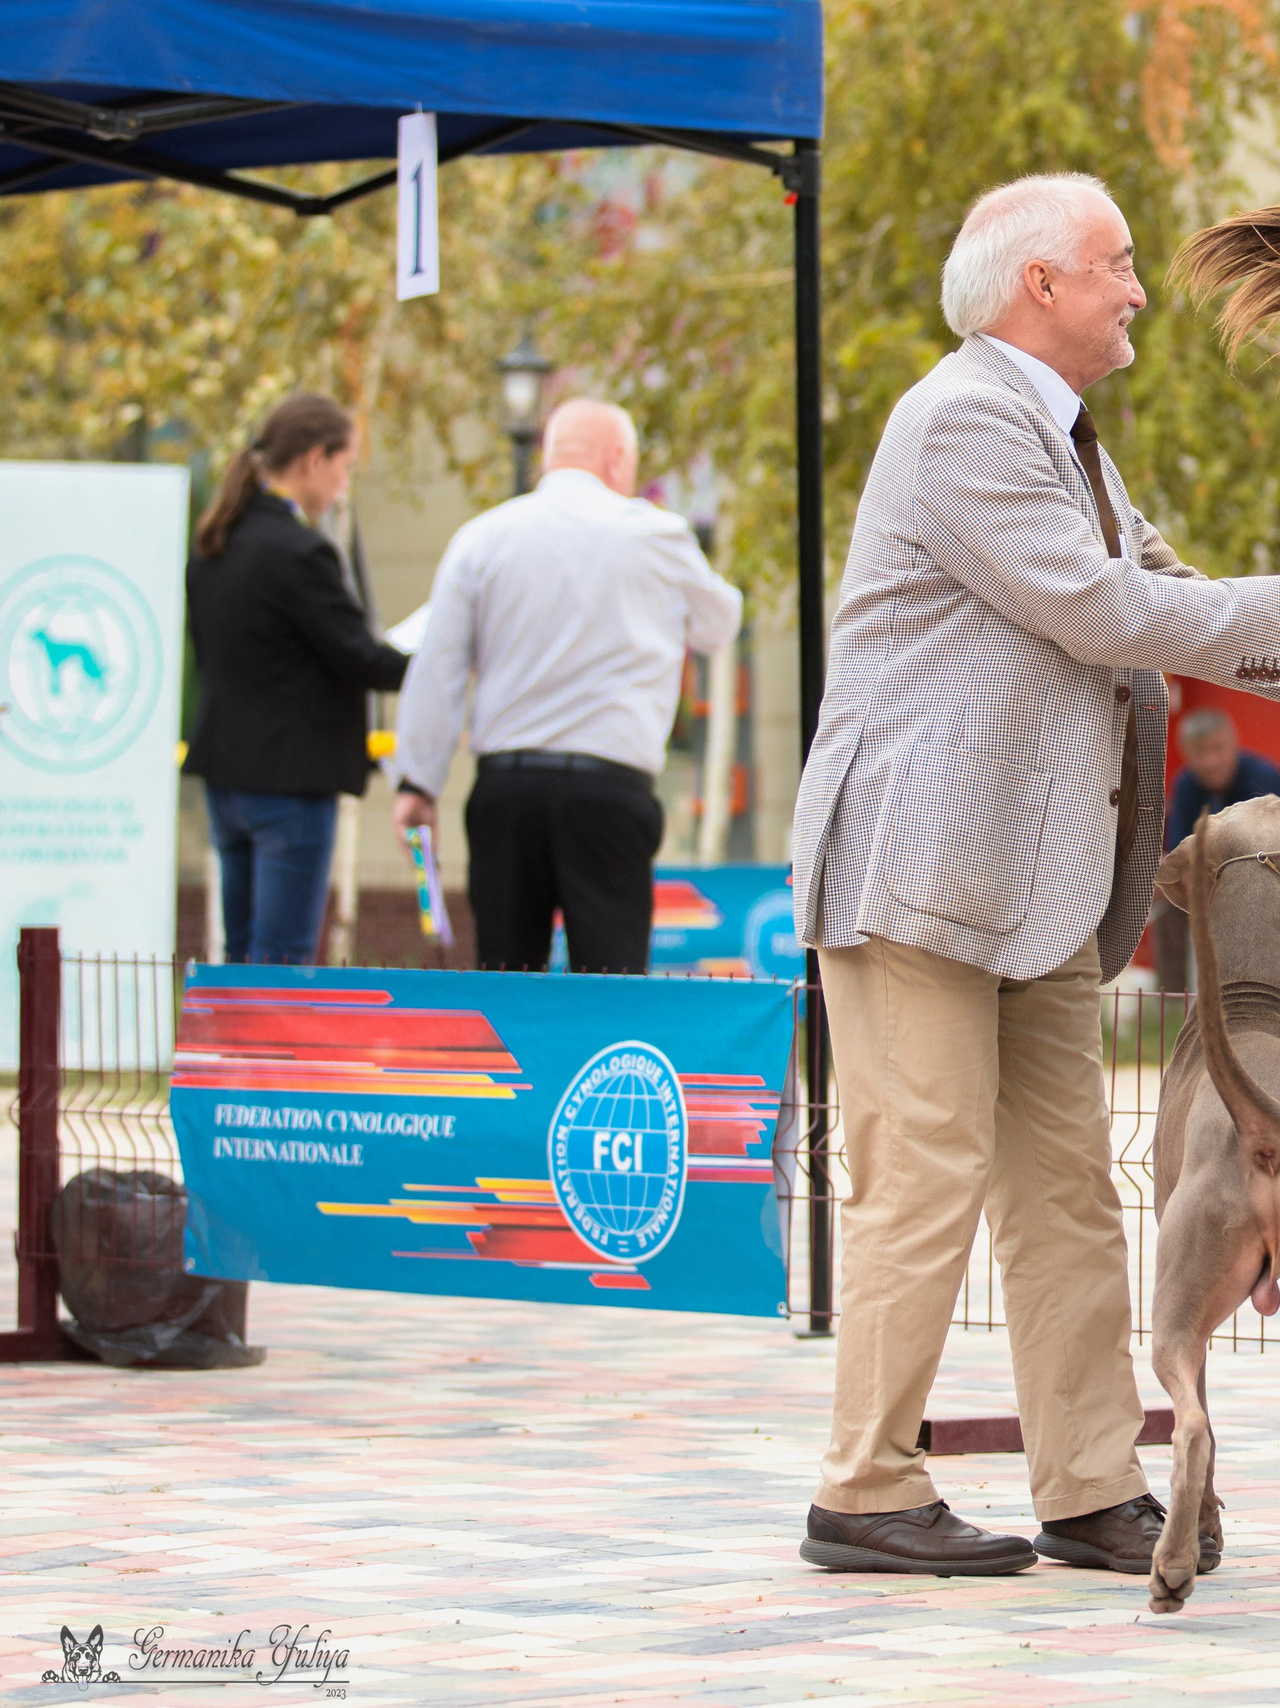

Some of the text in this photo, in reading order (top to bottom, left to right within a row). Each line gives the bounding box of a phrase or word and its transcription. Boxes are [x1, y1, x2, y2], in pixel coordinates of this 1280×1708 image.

[408, 159, 425, 277] 1
[214, 1103, 457, 1141] FEDERATION CYNOLOGIQUE
[213, 1136, 364, 1167] INTERNATIONALE
[555, 1053, 681, 1248] FEDERATION CYNOLOGIQUE INTERNATIONALE
[593, 1132, 644, 1173] FCI
